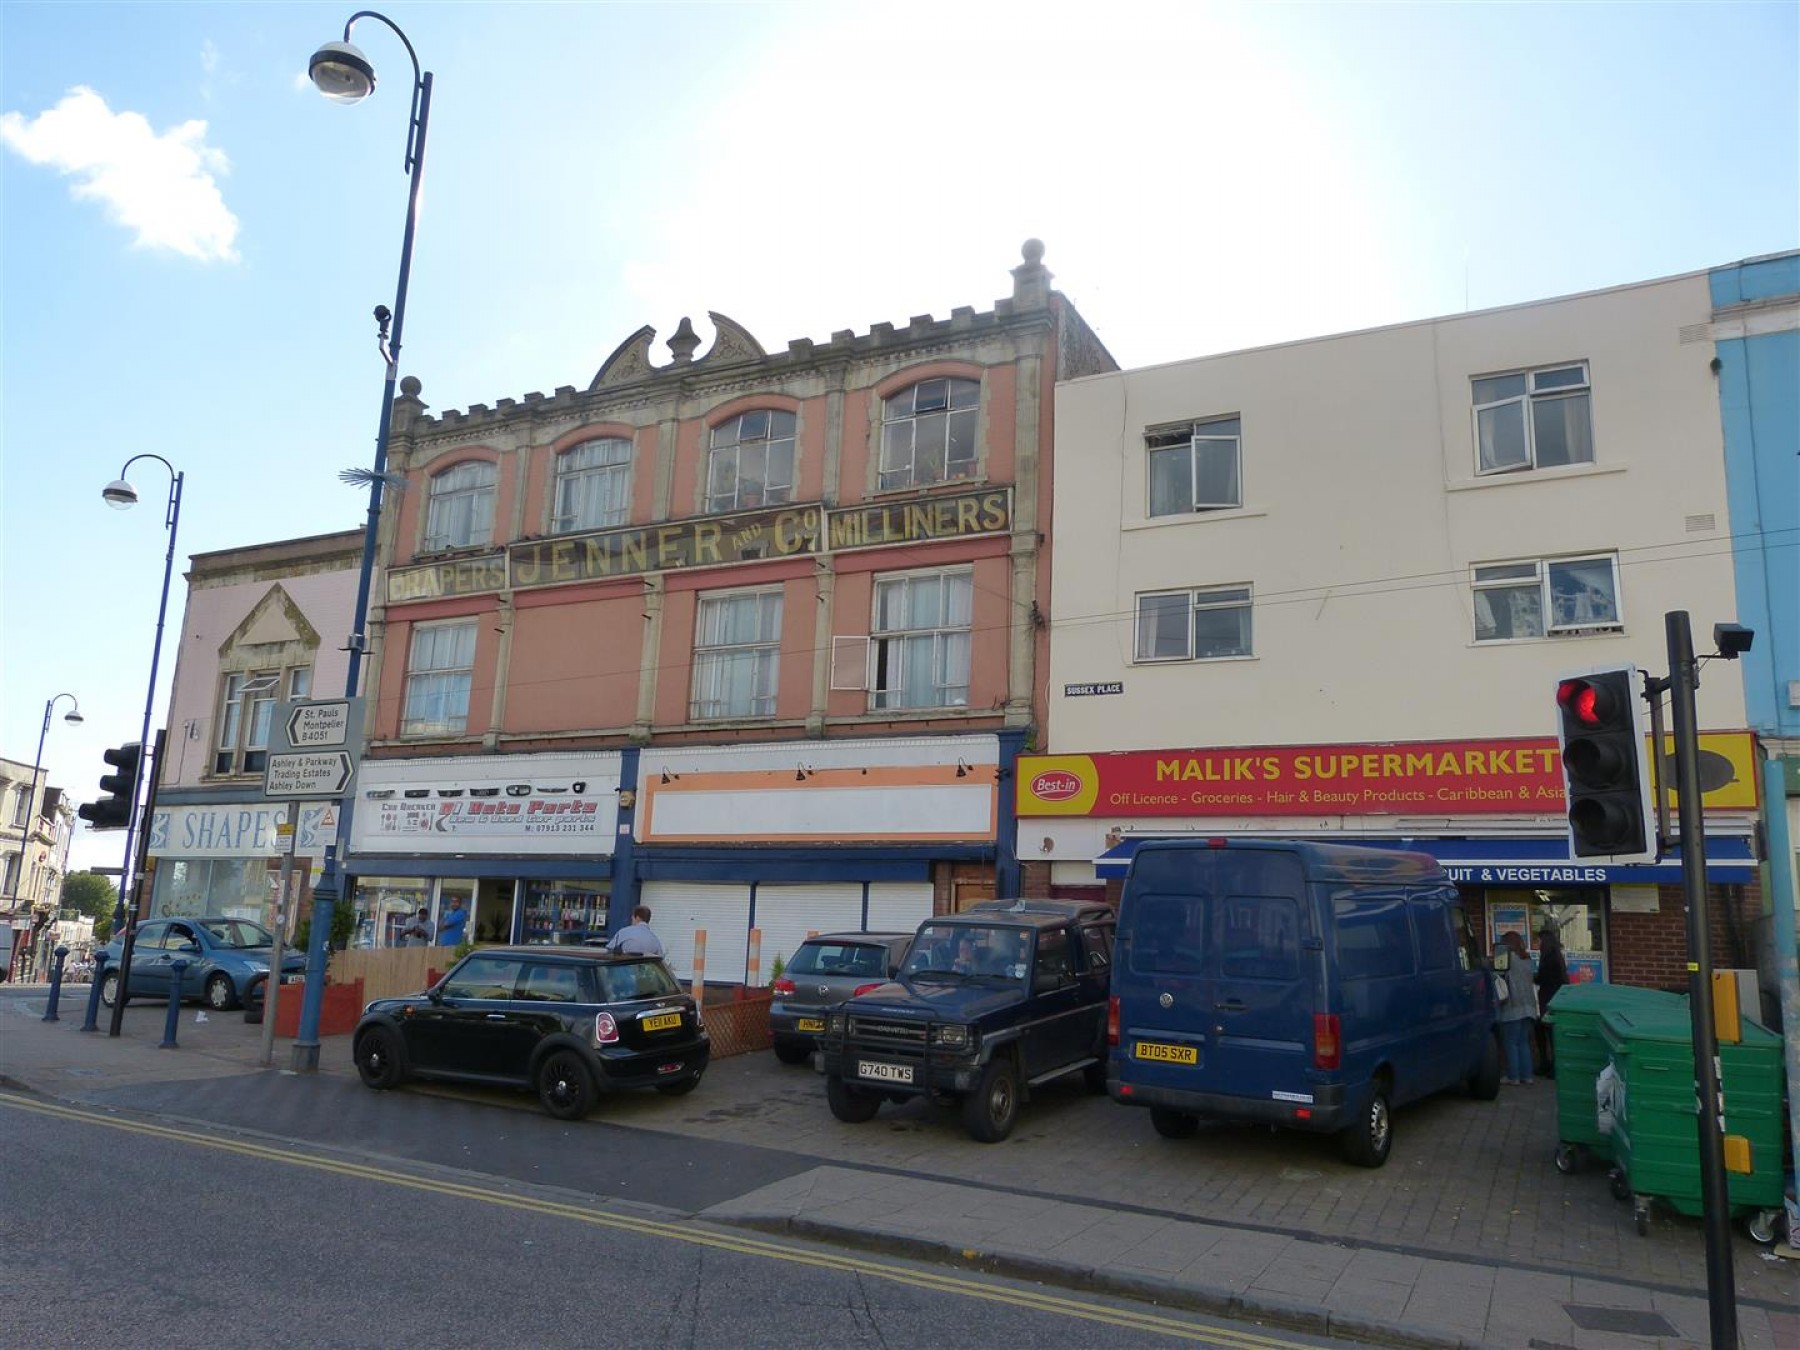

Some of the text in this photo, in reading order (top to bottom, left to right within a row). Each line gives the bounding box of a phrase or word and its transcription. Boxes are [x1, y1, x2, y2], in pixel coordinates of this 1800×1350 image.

[831, 495, 1006, 548] MILLINERS
[516, 521, 723, 584] JENNER
[732, 523, 762, 549] AND
[390, 560, 505, 602] DRAPERS
[1066, 684, 1120, 695] SUSSEX PLACE
[319, 709, 339, 718] Pauls
[304, 721, 344, 730] Montpelier
[302, 731, 329, 740] B4051
[272, 758, 337, 768] Ashley & Parkway
[1156, 748, 1561, 782] MALIK'S SUPERMARKET
[274, 769, 331, 779] Trading Estates
[269, 781, 316, 791] Ashley Down
[1036, 778, 1076, 793] Best-in
[1110, 792, 1130, 805] Off
[1133, 792, 1178, 805] Licence
[1191, 790, 1253, 804] Groceries
[1267, 791, 1295, 804] Hair
[1299, 790, 1309, 802] &
[1314, 789, 1359, 805] Beauty
[1364, 787, 1426, 802] Products
[1437, 786, 1513, 801] Caribbean
[1518, 785, 1530, 800] &
[1535, 785, 1566, 800] Asia
[468, 801, 521, 815] Auto
[527, 800, 598, 815] Parts
[182, 810, 288, 849] SHAPES
[1444, 868, 1606, 881] UIT & VEGETABLES
[1141, 1044, 1192, 1061] BT05 SXR
[860, 1063, 912, 1080] G740 TWS
